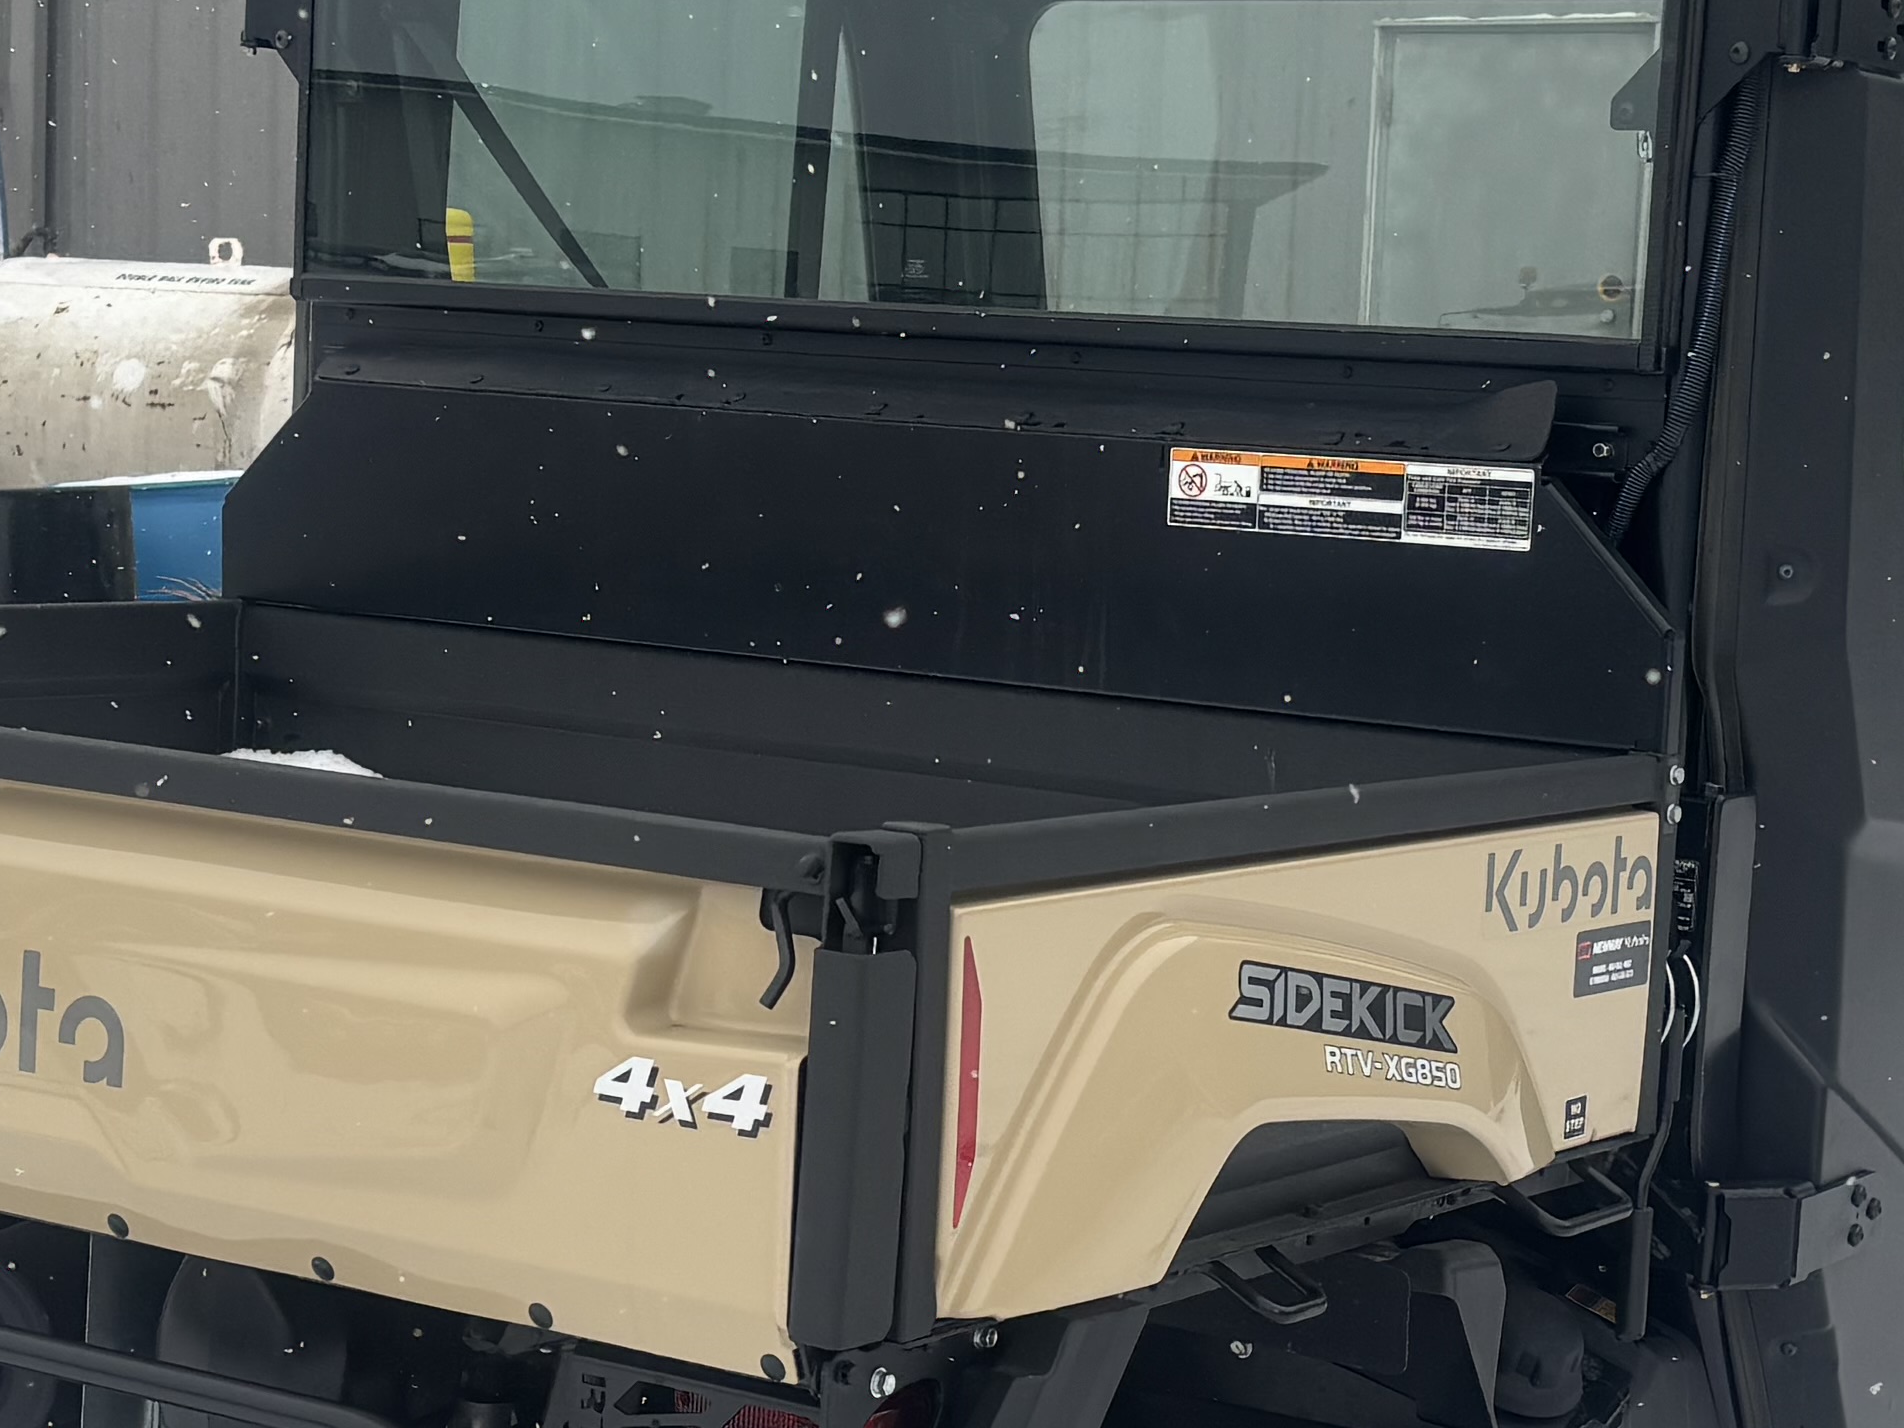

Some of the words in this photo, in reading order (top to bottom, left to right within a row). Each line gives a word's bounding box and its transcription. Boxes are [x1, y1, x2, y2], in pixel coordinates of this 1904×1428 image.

[1484, 835, 1653, 932] Kubota
[1229, 962, 1460, 1053] SIDEKICK
[593, 1056, 773, 1138] 4x4
[1323, 1043, 1463, 1091] RTV-XG850
